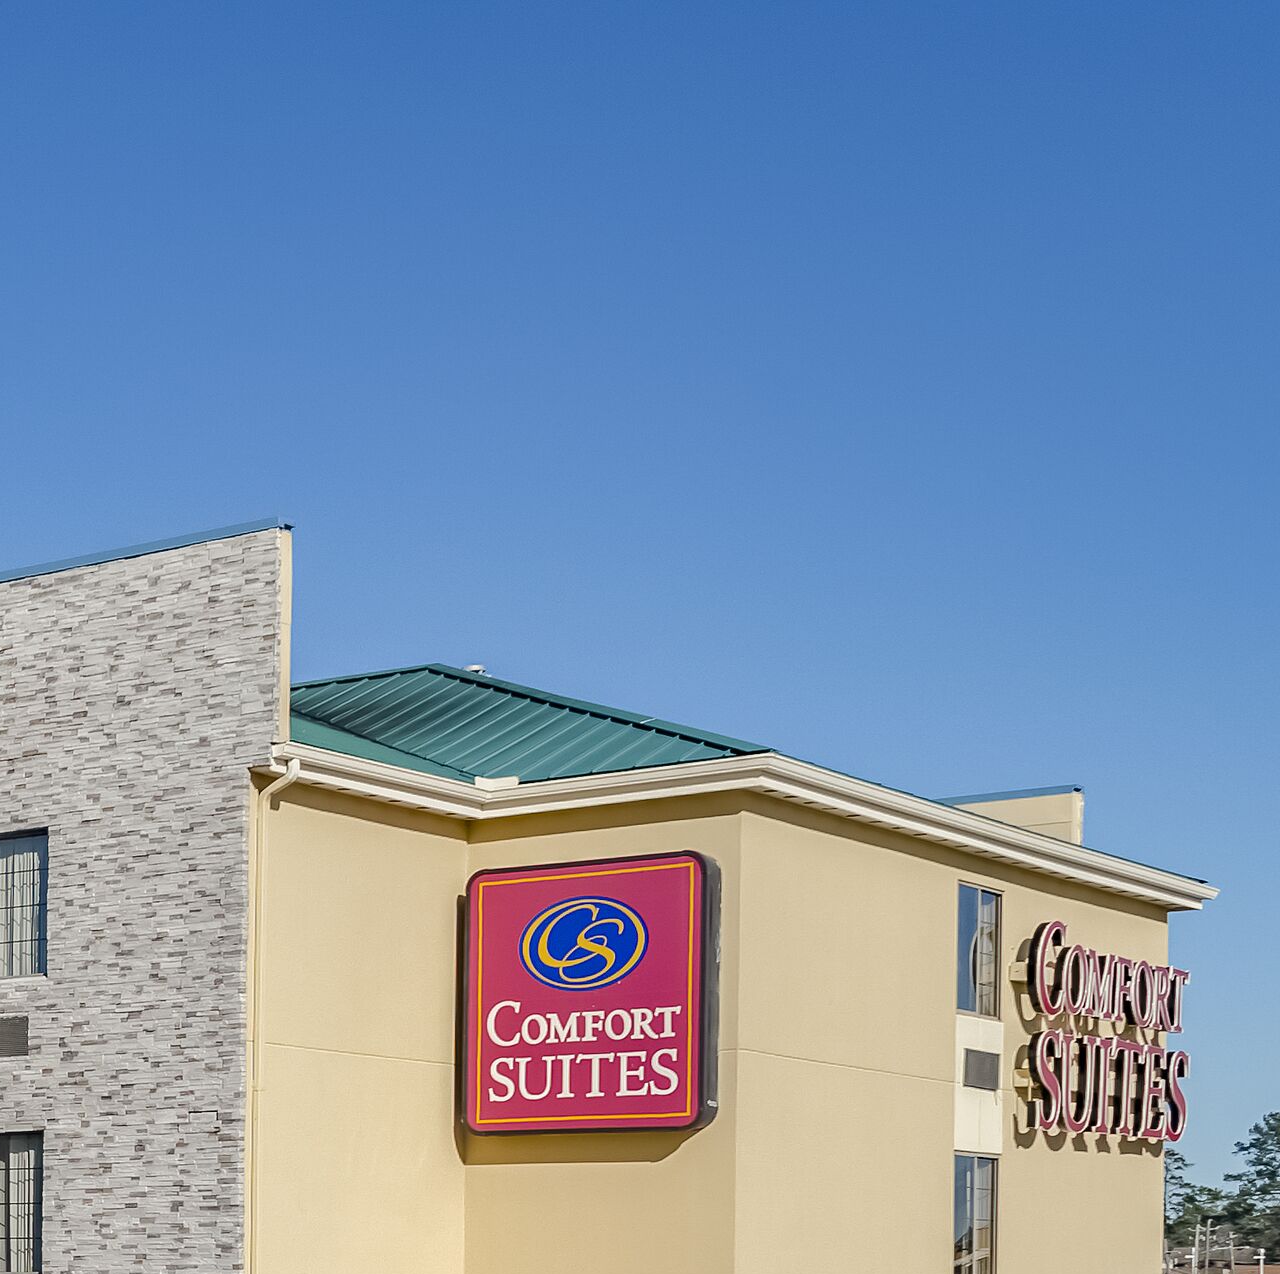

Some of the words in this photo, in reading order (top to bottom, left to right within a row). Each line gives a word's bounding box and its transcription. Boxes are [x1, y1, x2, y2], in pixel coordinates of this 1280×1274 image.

[1036, 920, 1189, 1033] COMFORT
[486, 1001, 682, 1047] COMFORT
[488, 1048, 679, 1102] SUITES
[1036, 1029, 1190, 1142] SUITES
